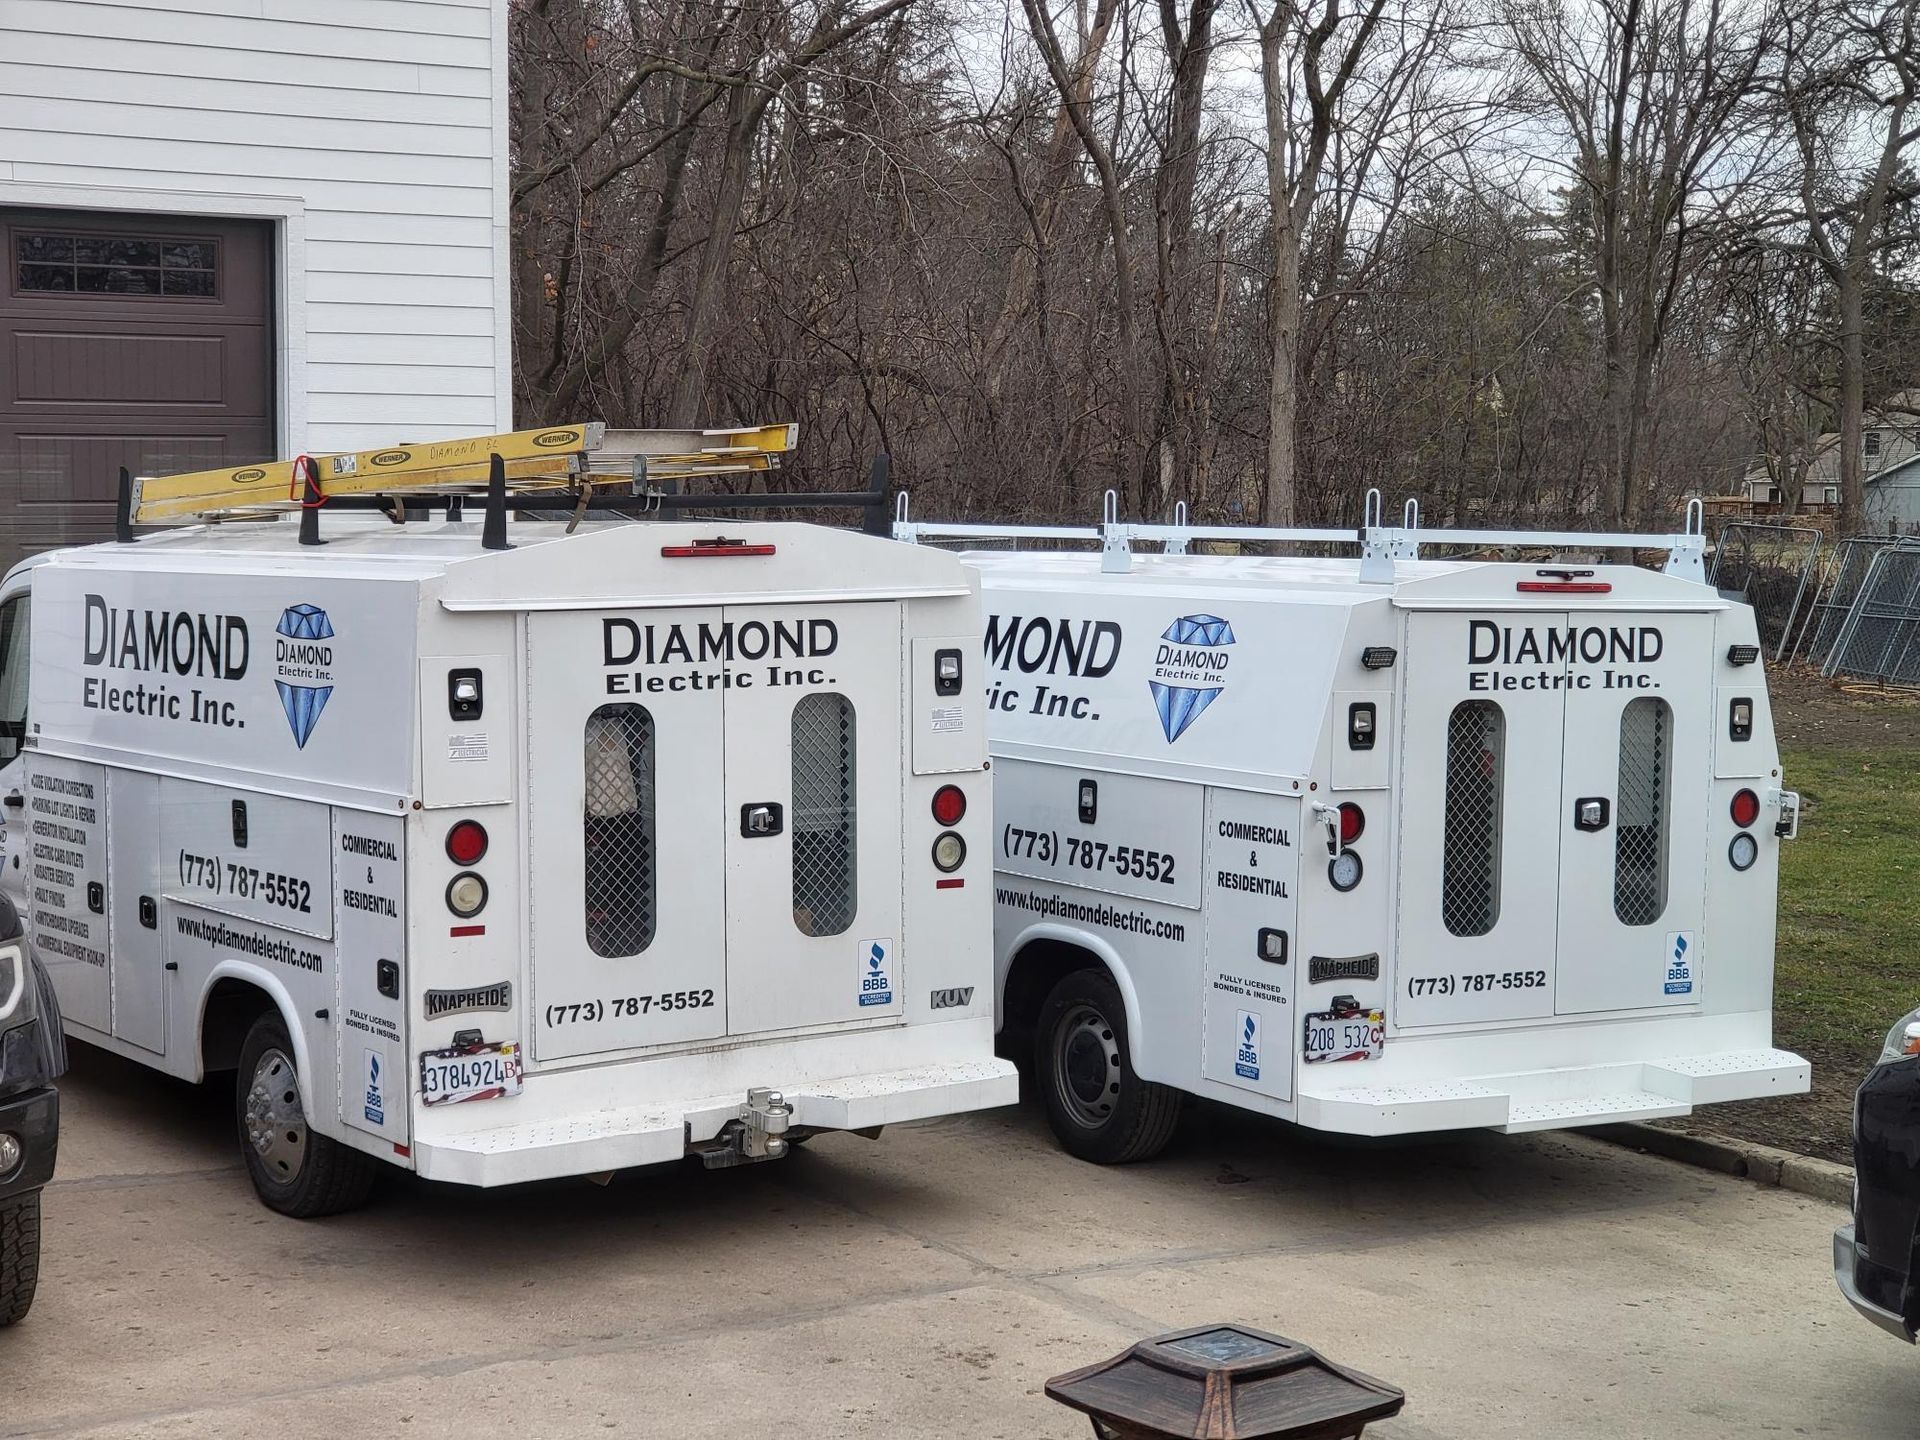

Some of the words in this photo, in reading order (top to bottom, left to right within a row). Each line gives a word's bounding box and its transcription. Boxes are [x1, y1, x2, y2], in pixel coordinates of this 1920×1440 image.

[430, 441, 476, 460] DIAMOND
[541, 433, 571, 444] WERNER
[378, 453, 404, 463] WERNER
[237, 470, 260, 480] WERNER
[83, 594, 249, 681] DIAMOND
[602, 617, 839, 666] DIAMOND
[984, 615, 1122, 678] MOND
[1468, 620, 1664, 664] DIAMOND
[276, 638, 333, 666] DIAMOND
[1155, 644, 1229, 670] DIAMOND
[277, 665, 313, 679] Electric
[315, 670, 334, 681] Inc.
[606, 668, 753, 694] Electric
[767, 666, 837, 687] Inc.
[1155, 667, 1199, 681] Electric
[1203, 671, 1226, 683] Inc.
[1469, 670, 1591, 691] Electric
[1603, 670, 1661, 688] Inc.
[83, 678, 181, 720] Electric
[190, 689, 245, 728] Inc.
[1029, 685, 1100, 721] Inc.
[1218, 820, 1291, 848] COMMERCIAL
[342, 833, 397, 862] COMMERCIAL
[1003, 823, 1058, 867] (773)
[1066, 837, 1176, 885] 787-5552
[1249, 850, 1258, 867] &
[178, 849, 221, 894] (773)
[227, 864, 311, 913] 787-5552
[367, 866, 374, 885] &
[1217, 870, 1289, 899] RESIDENTIAL
[343, 888, 398, 918] RESIDENTIAL
[996, 887, 1185, 942] www.topdiamondelectric.com
[177, 915, 323, 974] www.topdiamondelectric.com
[1311, 956, 1377, 980] KNAPHEIDE
[1668, 968, 1689, 980] BBB
[863, 978, 888, 991] BBB
[1213, 982, 1244, 995] BONDED
[1253, 991, 1287, 1005] INSURED
[1219, 973, 1243, 985] FULLY
[1244, 978, 1281, 994] LICENSED
[1408, 974, 1455, 998] (773)
[1462, 970, 1546, 993] 787-5552
[427, 985, 509, 1016] KNAPHEIDE
[546, 998, 604, 1028] (773)
[612, 989, 715, 1018] 787-5552
[931, 987, 975, 1009] KUV
[345, 1018, 369, 1031] BONDED
[376, 1027, 400, 1042] INSURED
[350, 1009, 368, 1021] FULLY
[369, 1015, 396, 1030] LICENSED
[1310, 1027, 1335, 1051] 208
[1239, 1049, 1257, 1065] BBB
[366, 1091, 381, 1107] BBB
